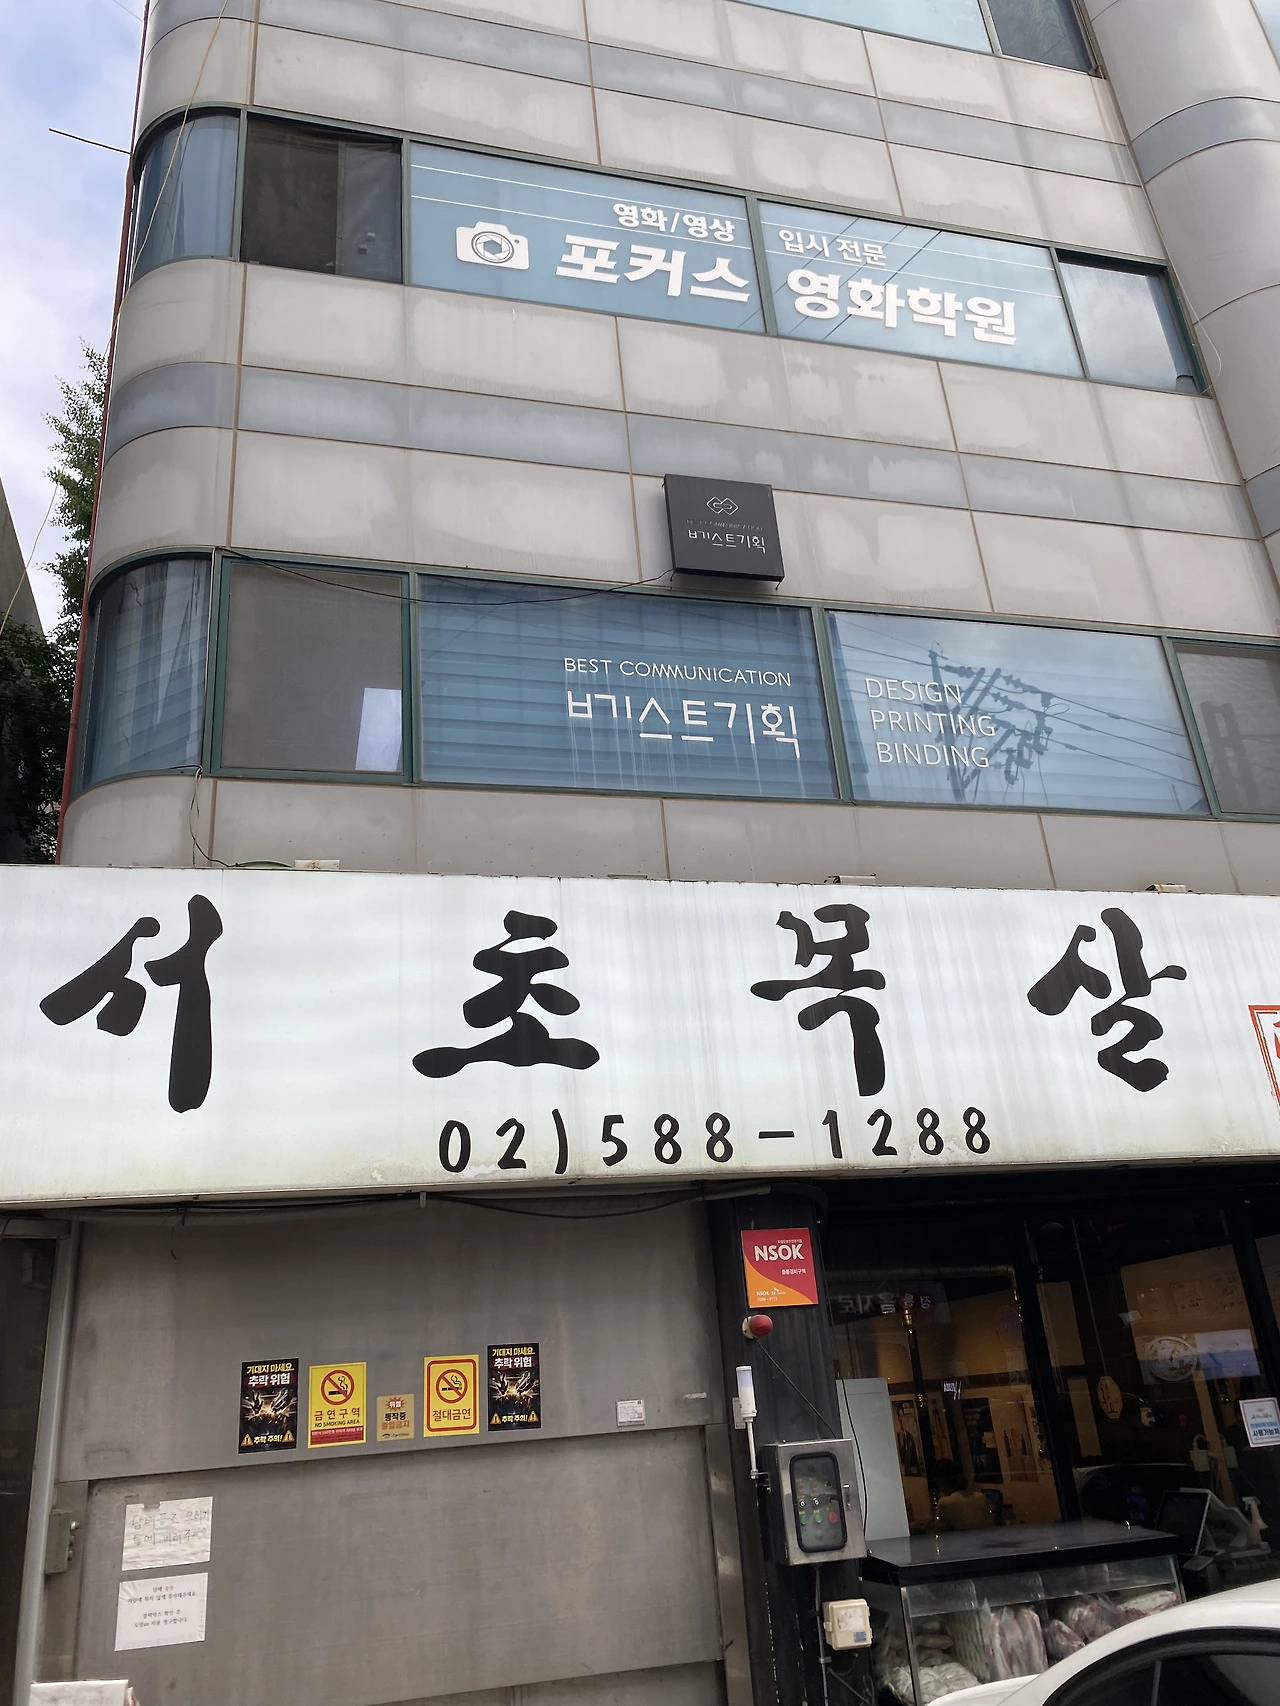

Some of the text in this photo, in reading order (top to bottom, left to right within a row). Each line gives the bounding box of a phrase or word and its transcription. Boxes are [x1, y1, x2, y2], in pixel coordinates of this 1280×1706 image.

[612, 201, 888, 268] 영화/영상 입시 전문
[555, 235, 1017, 346] 포커스 영화학원
[564, 657, 792, 687] BEST COMMUNICATION
[865, 678, 962, 703] DESIGN
[870, 710, 996, 737] PRINTING
[876, 741, 990, 768] BINDING
[438, 1106, 991, 1175] 02)588-1288
[754, 1243, 805, 1262] NSOK
[491, 1347, 513, 1357] 기대지
[494, 1356, 532, 1369] 추락 위험
[246, 1363, 270, 1375] 기대지
[248, 1372, 291, 1387] 추락 위험
[432, 1409, 471, 1422] 절대금연
[253, 1435, 267, 1444] 추락
